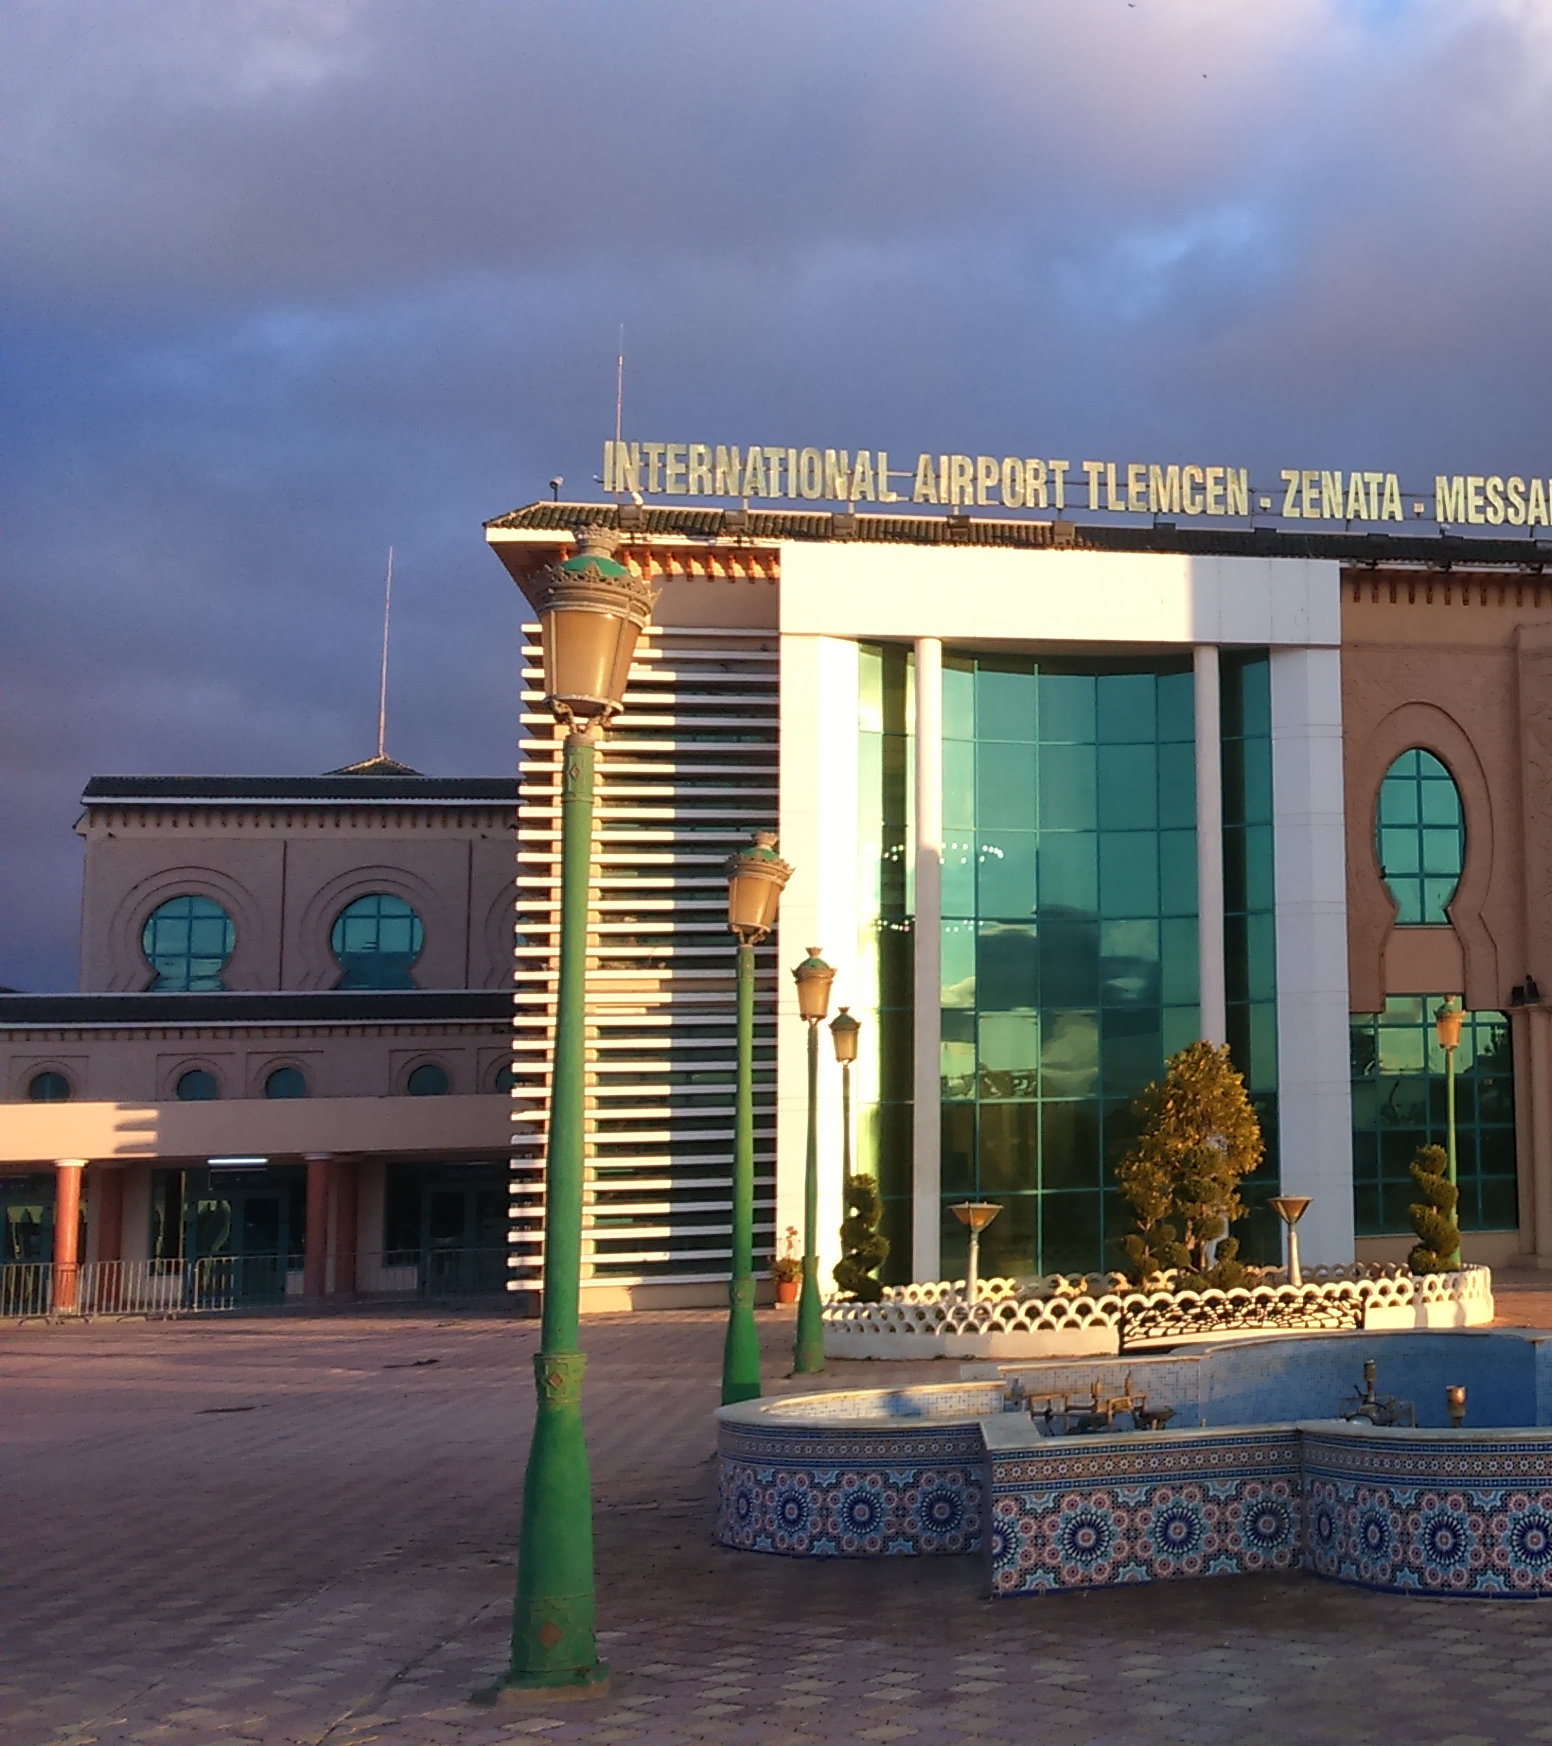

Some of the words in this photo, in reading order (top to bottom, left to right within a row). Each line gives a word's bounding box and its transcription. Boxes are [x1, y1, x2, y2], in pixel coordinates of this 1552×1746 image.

[603, 440, 898, 502] INTERNATIONAL
[912, 454, 1070, 510] AIRPORT
[1083, 460, 1250, 516] TLEMCEN
[1280, 469, 1404, 523] ZENATA
